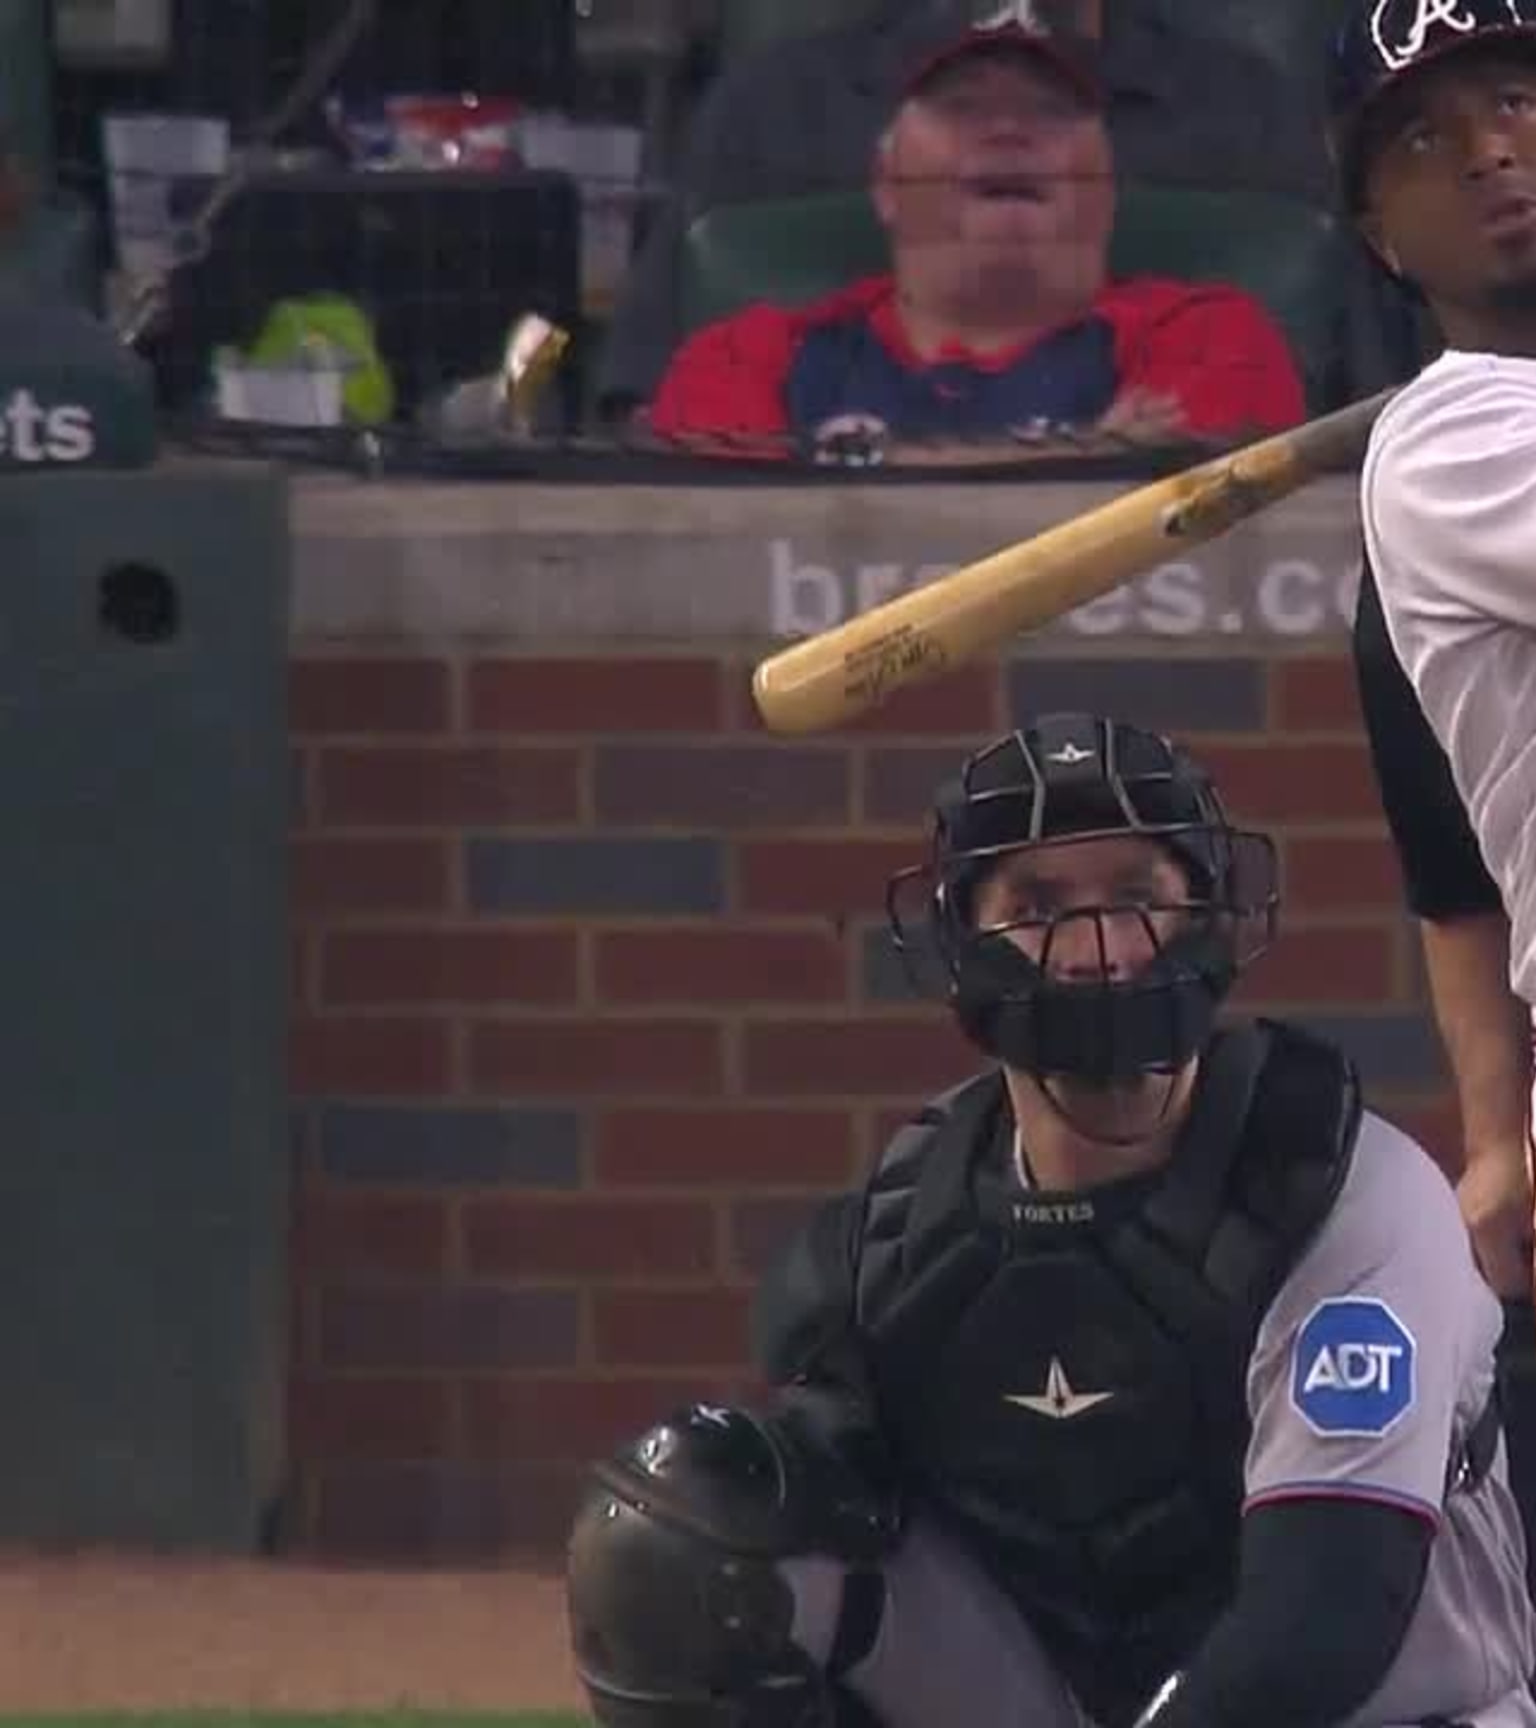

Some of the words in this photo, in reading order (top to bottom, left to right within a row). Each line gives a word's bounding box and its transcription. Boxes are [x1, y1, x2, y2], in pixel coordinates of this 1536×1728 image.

[1371, 0, 1477, 70] A
[0, 388, 94, 461] ts
[1303, 1343, 1403, 1392] ADT
